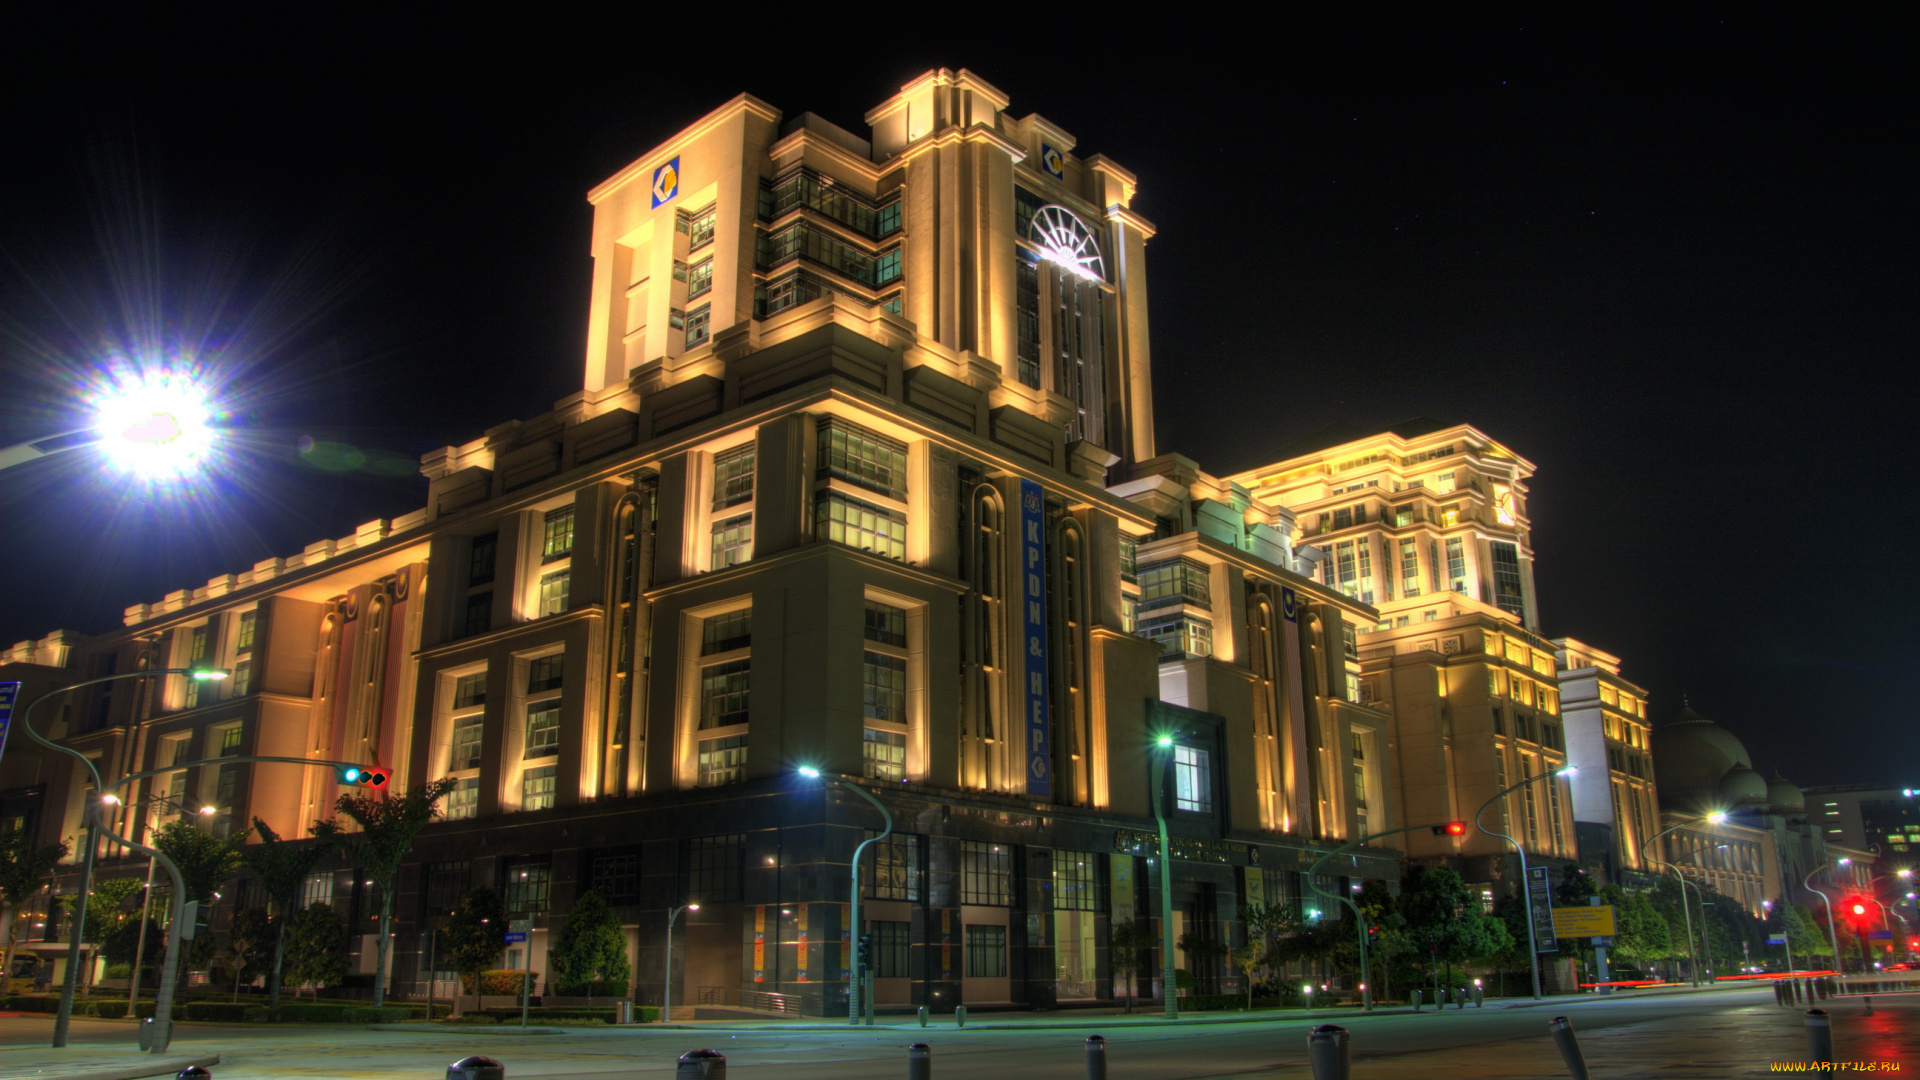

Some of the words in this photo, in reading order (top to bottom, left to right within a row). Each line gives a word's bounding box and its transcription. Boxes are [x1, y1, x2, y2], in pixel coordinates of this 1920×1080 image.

[1027, 519, 1041, 626] KPDN
[1029, 636, 1042, 658] &
[1030, 671, 1044, 753] HEP
